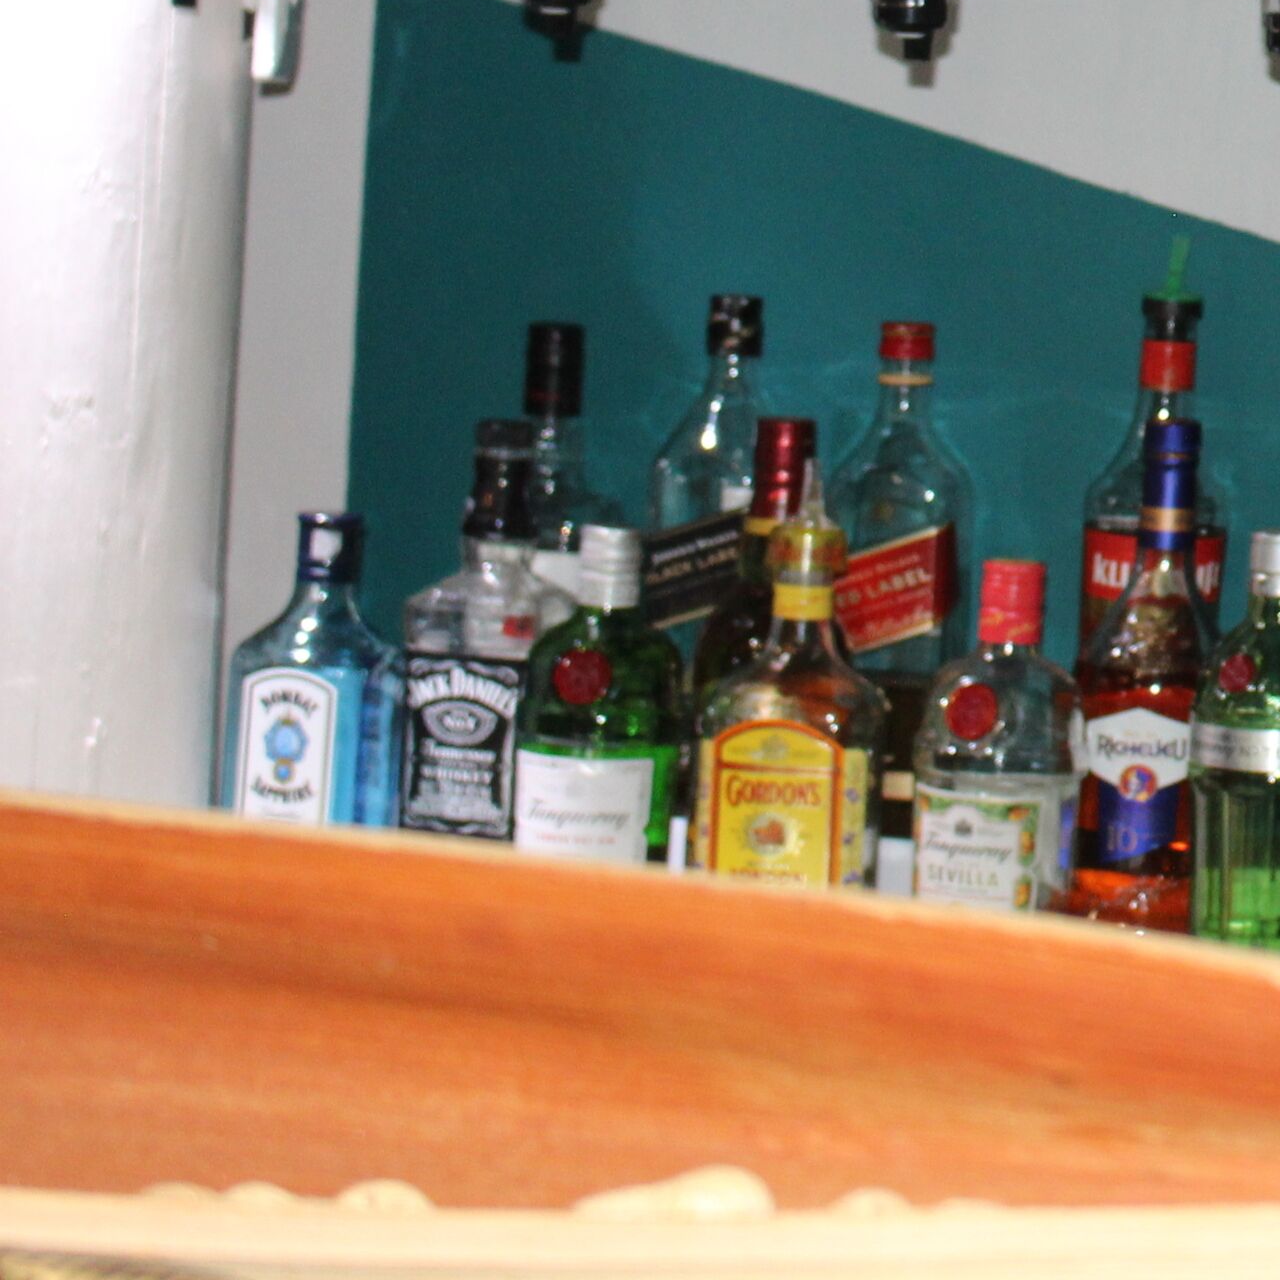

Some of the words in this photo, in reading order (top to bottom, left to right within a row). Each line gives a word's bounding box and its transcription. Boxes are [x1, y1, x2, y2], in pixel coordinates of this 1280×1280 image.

[866, 567, 935, 599] LABEL
[406, 672, 449, 709] JACK
[726, 774, 822, 807] GORDON'S
